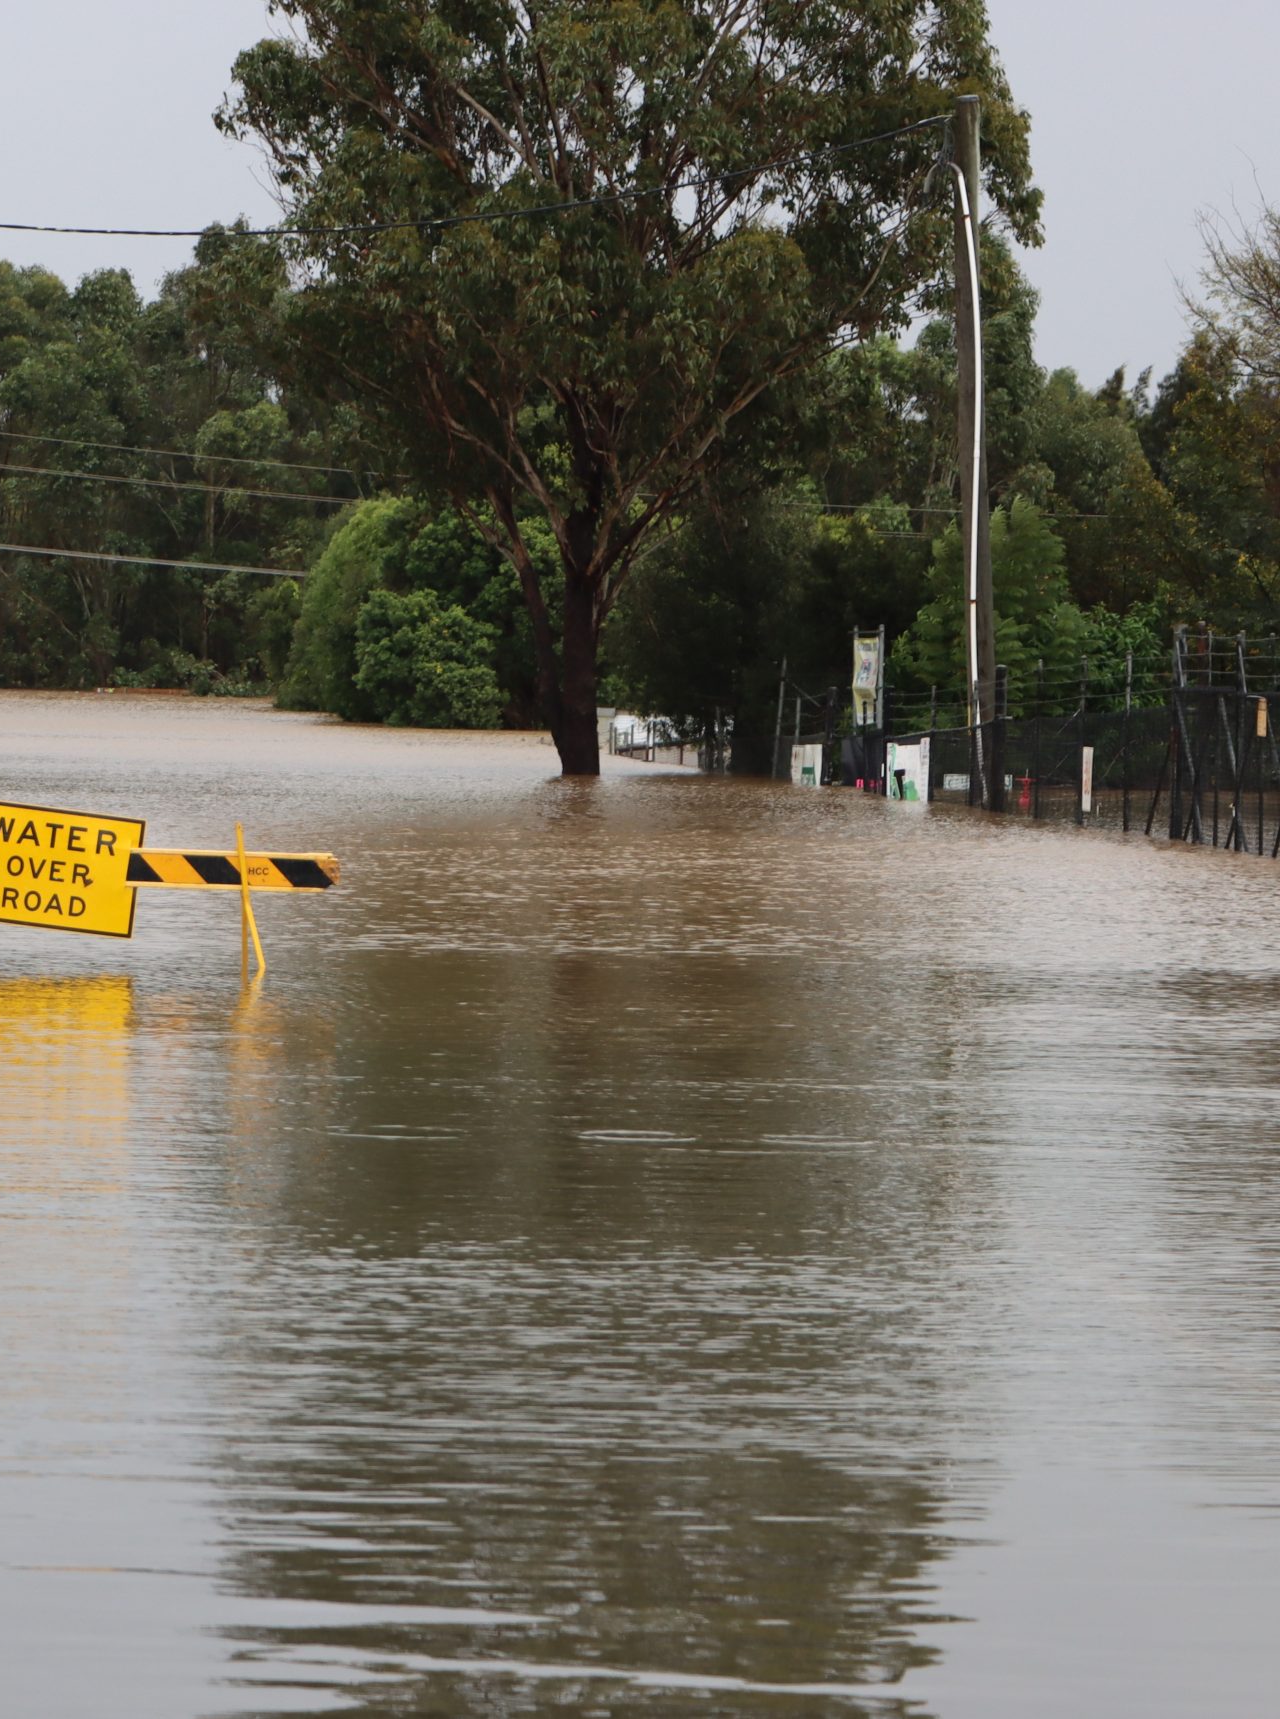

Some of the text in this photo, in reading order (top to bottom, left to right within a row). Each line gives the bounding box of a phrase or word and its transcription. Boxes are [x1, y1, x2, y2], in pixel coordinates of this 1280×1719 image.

[6, 855, 92, 887] OVER
[248, 867, 270, 876] HCC
[1, 887, 87, 917] ROAD
